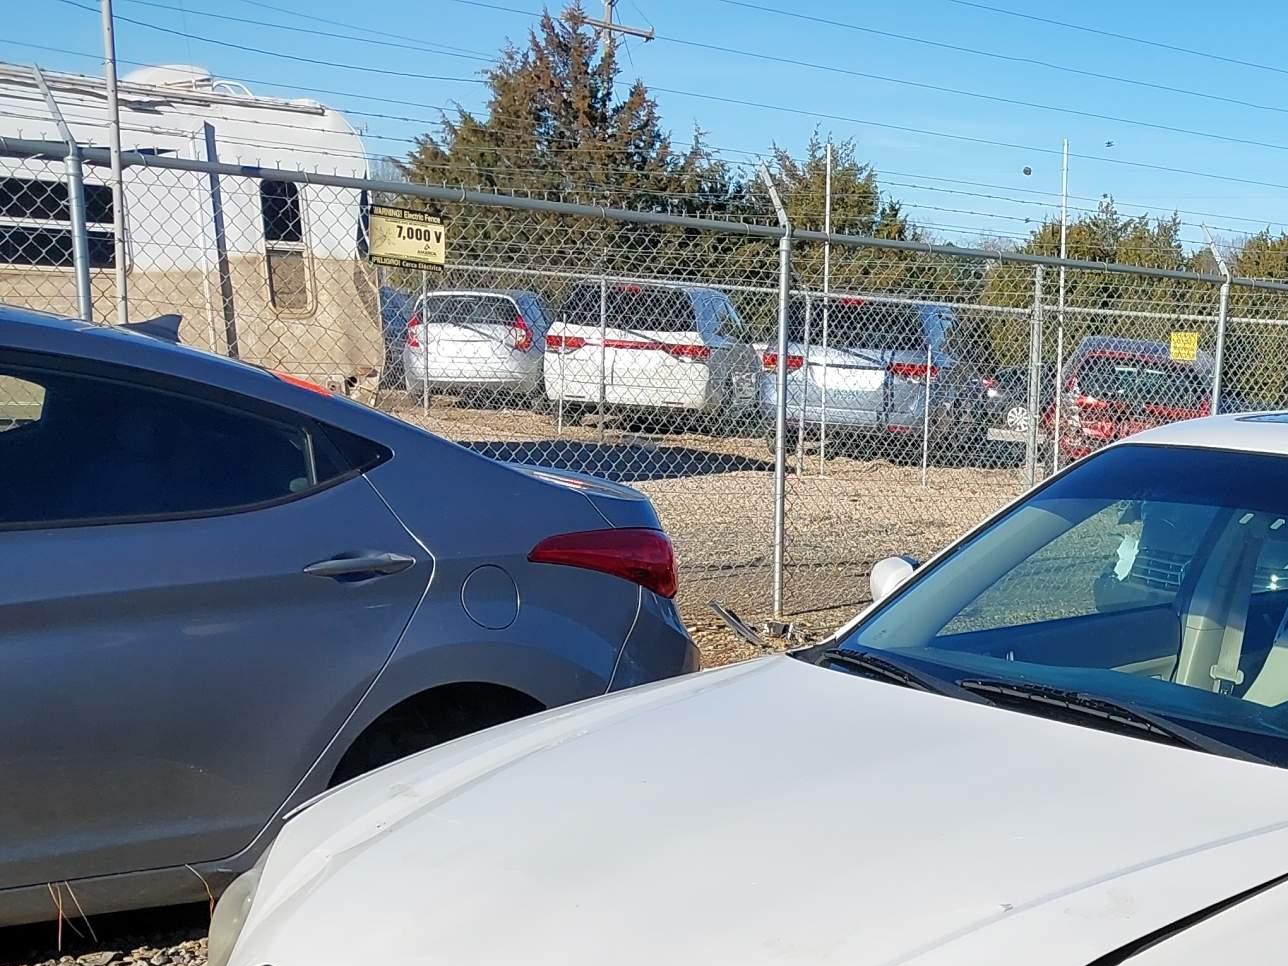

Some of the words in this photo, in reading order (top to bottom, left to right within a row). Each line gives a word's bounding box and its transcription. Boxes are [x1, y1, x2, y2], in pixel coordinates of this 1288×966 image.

[403, 211, 424, 220] Electric
[424, 213, 441, 223] Fence
[396, 225, 431, 242] 7,000
[434, 231, 442, 244] V
